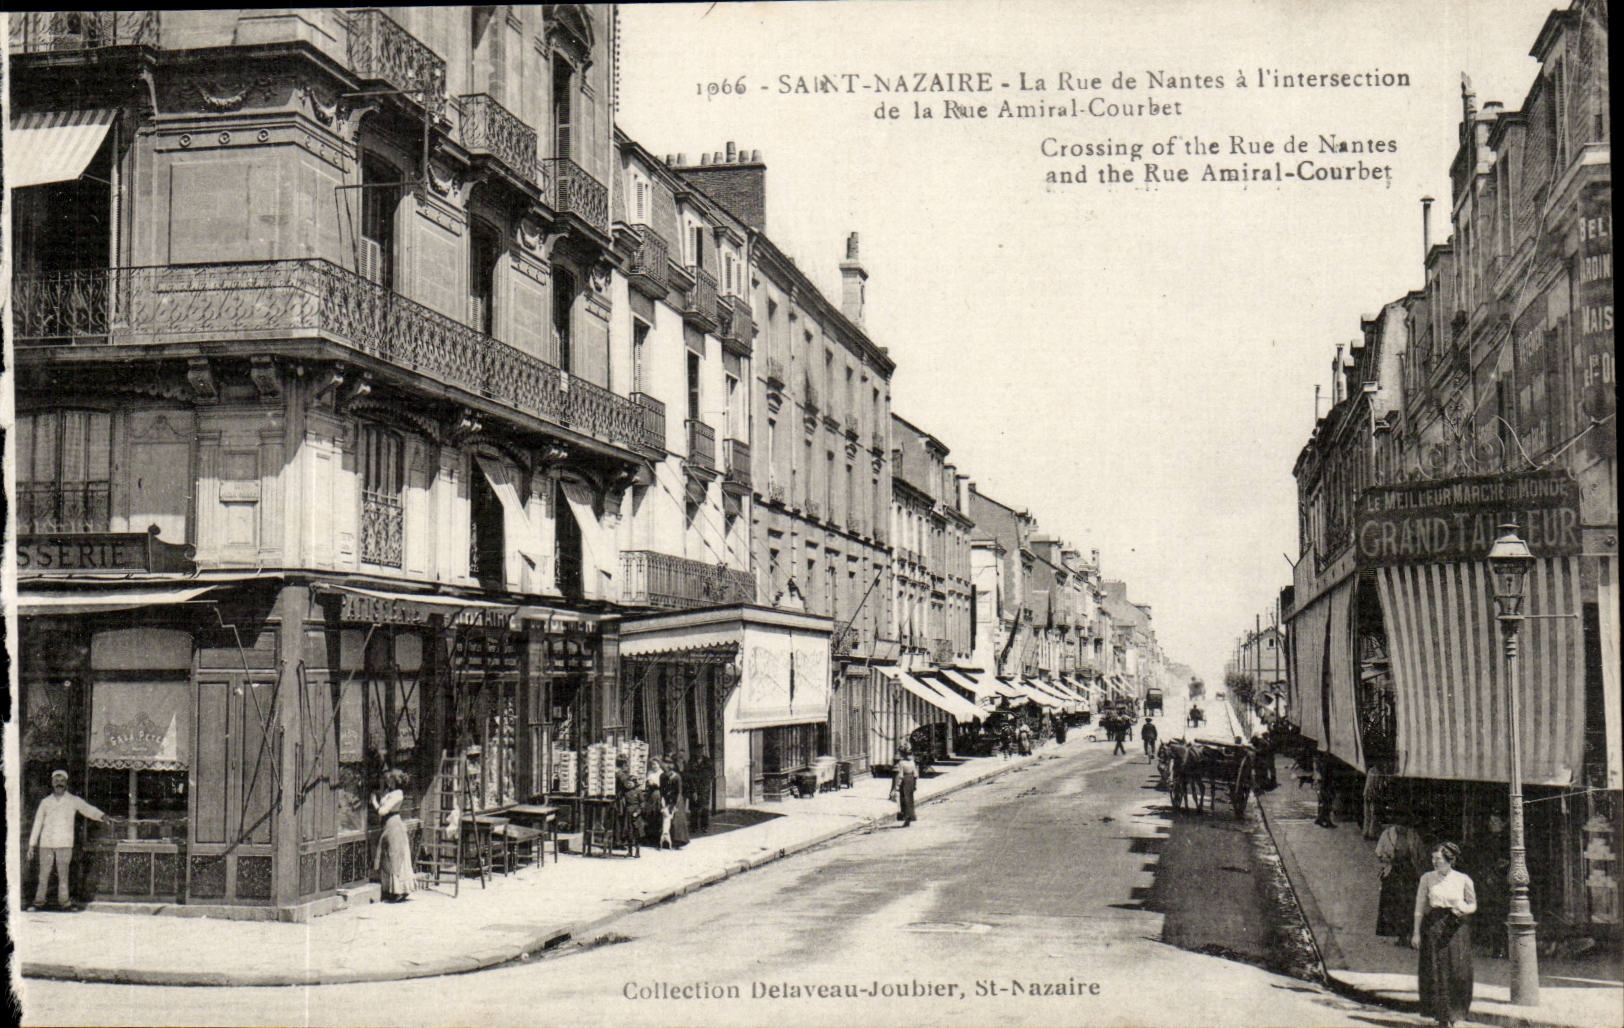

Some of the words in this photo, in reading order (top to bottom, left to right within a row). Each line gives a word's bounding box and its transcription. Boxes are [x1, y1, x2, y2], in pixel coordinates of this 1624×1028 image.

[1366, 494, 1382, 513] LE
[1384, 487, 1452, 512] MEILLEUR
[1519, 477, 1568, 500] MONDE
[1360, 517, 1450, 557] GRAND
[17, 542, 128, 570] SSERIE
